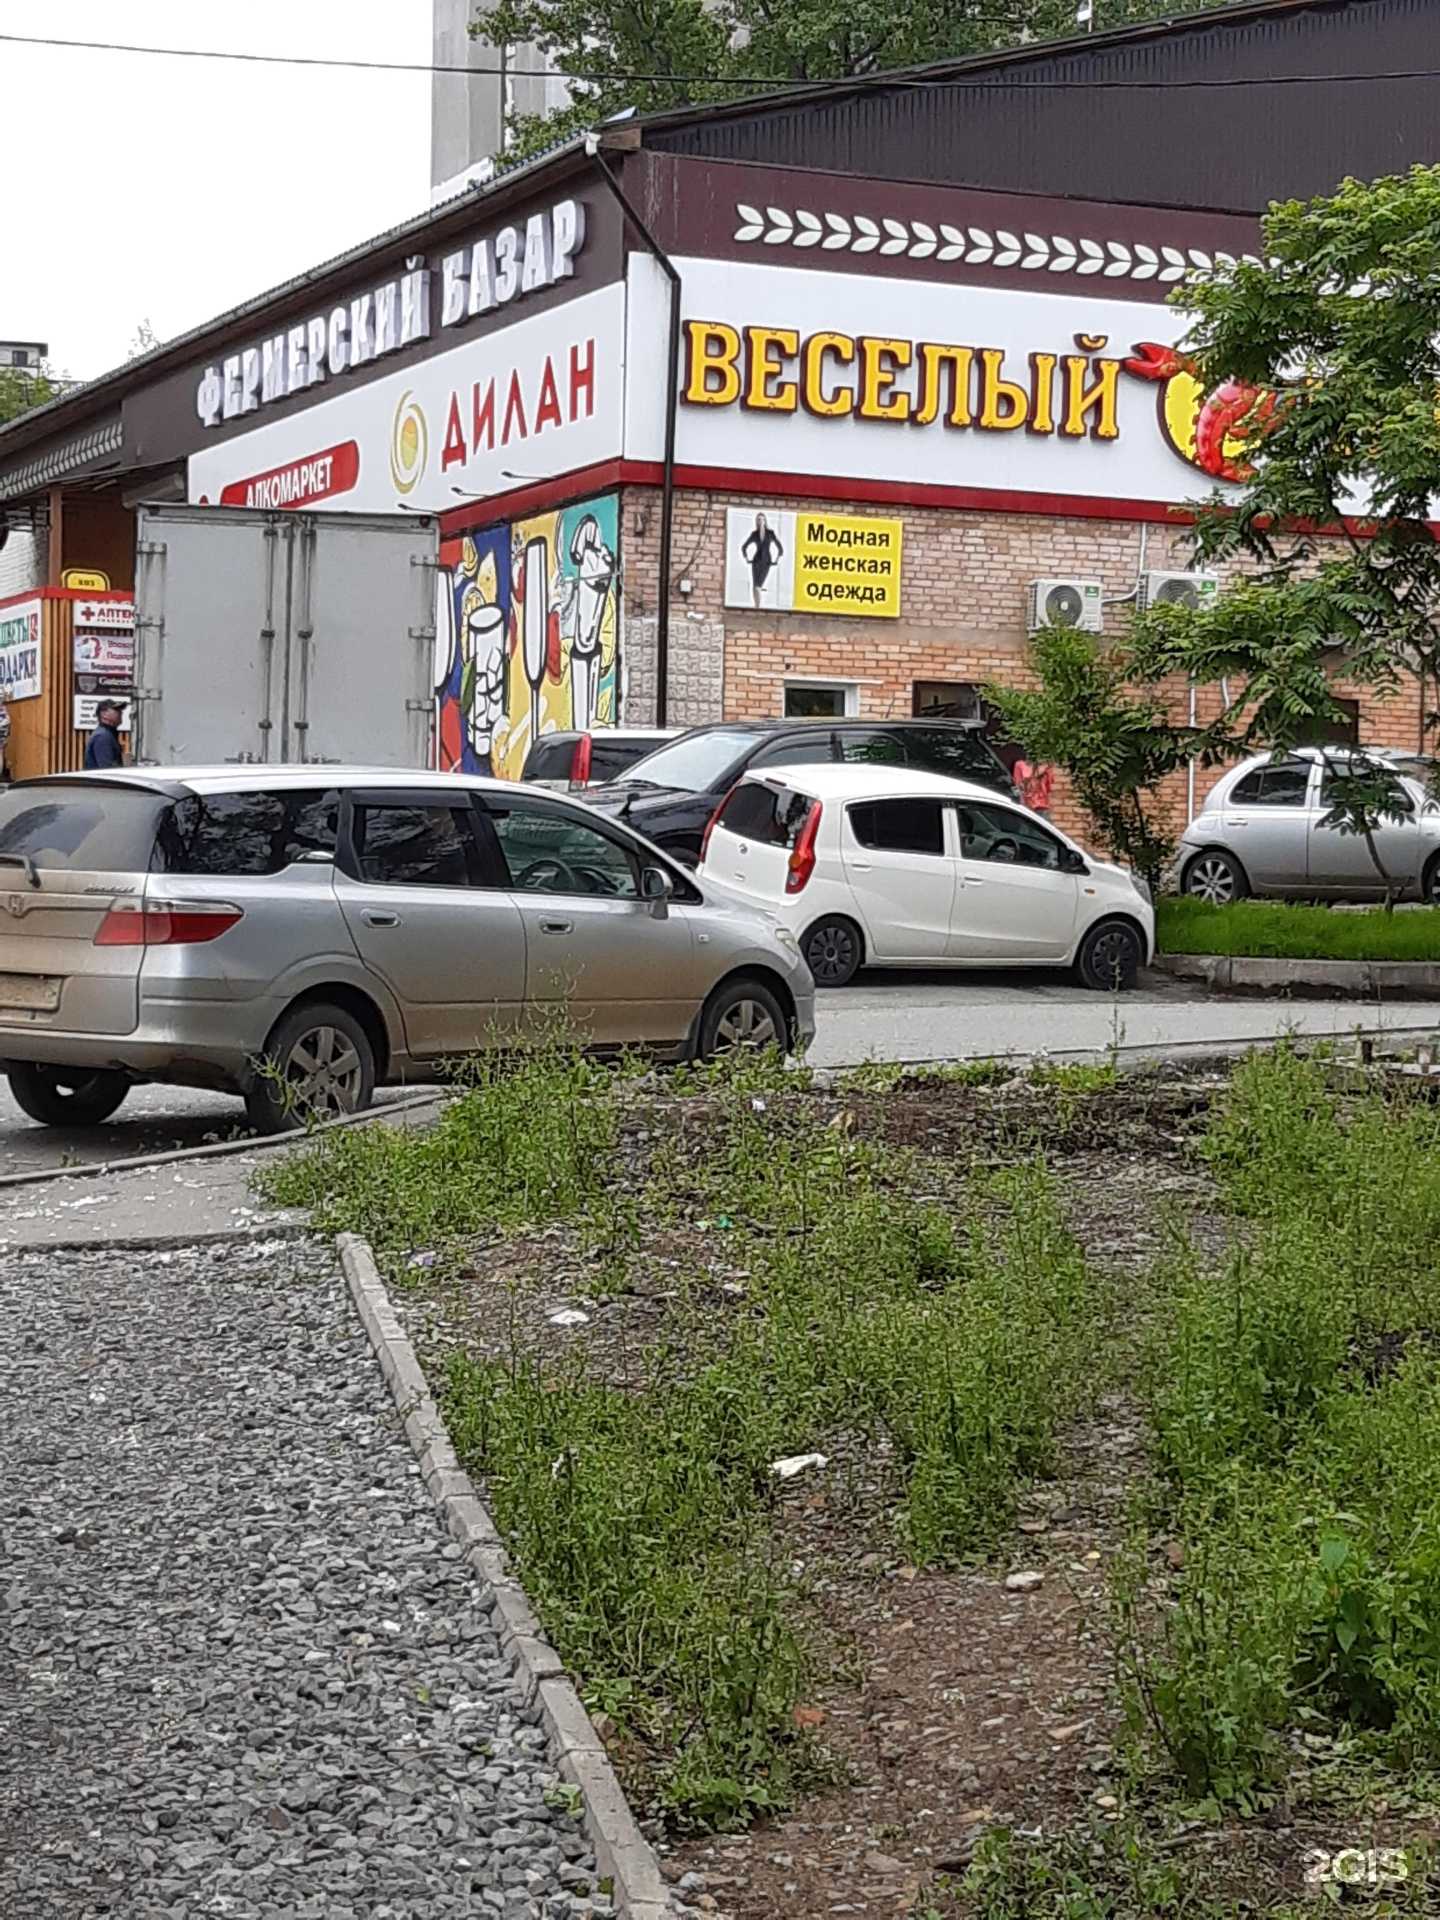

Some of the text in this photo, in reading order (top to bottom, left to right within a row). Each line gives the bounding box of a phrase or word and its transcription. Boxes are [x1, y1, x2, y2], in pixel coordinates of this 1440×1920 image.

[197, 200, 585, 428] ФЕРМЕРСКИЙ БАЗАР
[681, 319, 1126, 441] ВЕСЕЛЫЙ
[441, 338, 596, 473] ДИЛАН
[246, 456, 333, 508] АЛКОМАРКЕТ
[807, 523, 890, 547] Модная
[803, 554, 891, 575] женская
[806, 582, 886, 604] одежда
[97, 607, 135, 619] АПТЕК
[0, 648, 37, 684] ОДАРКИ
